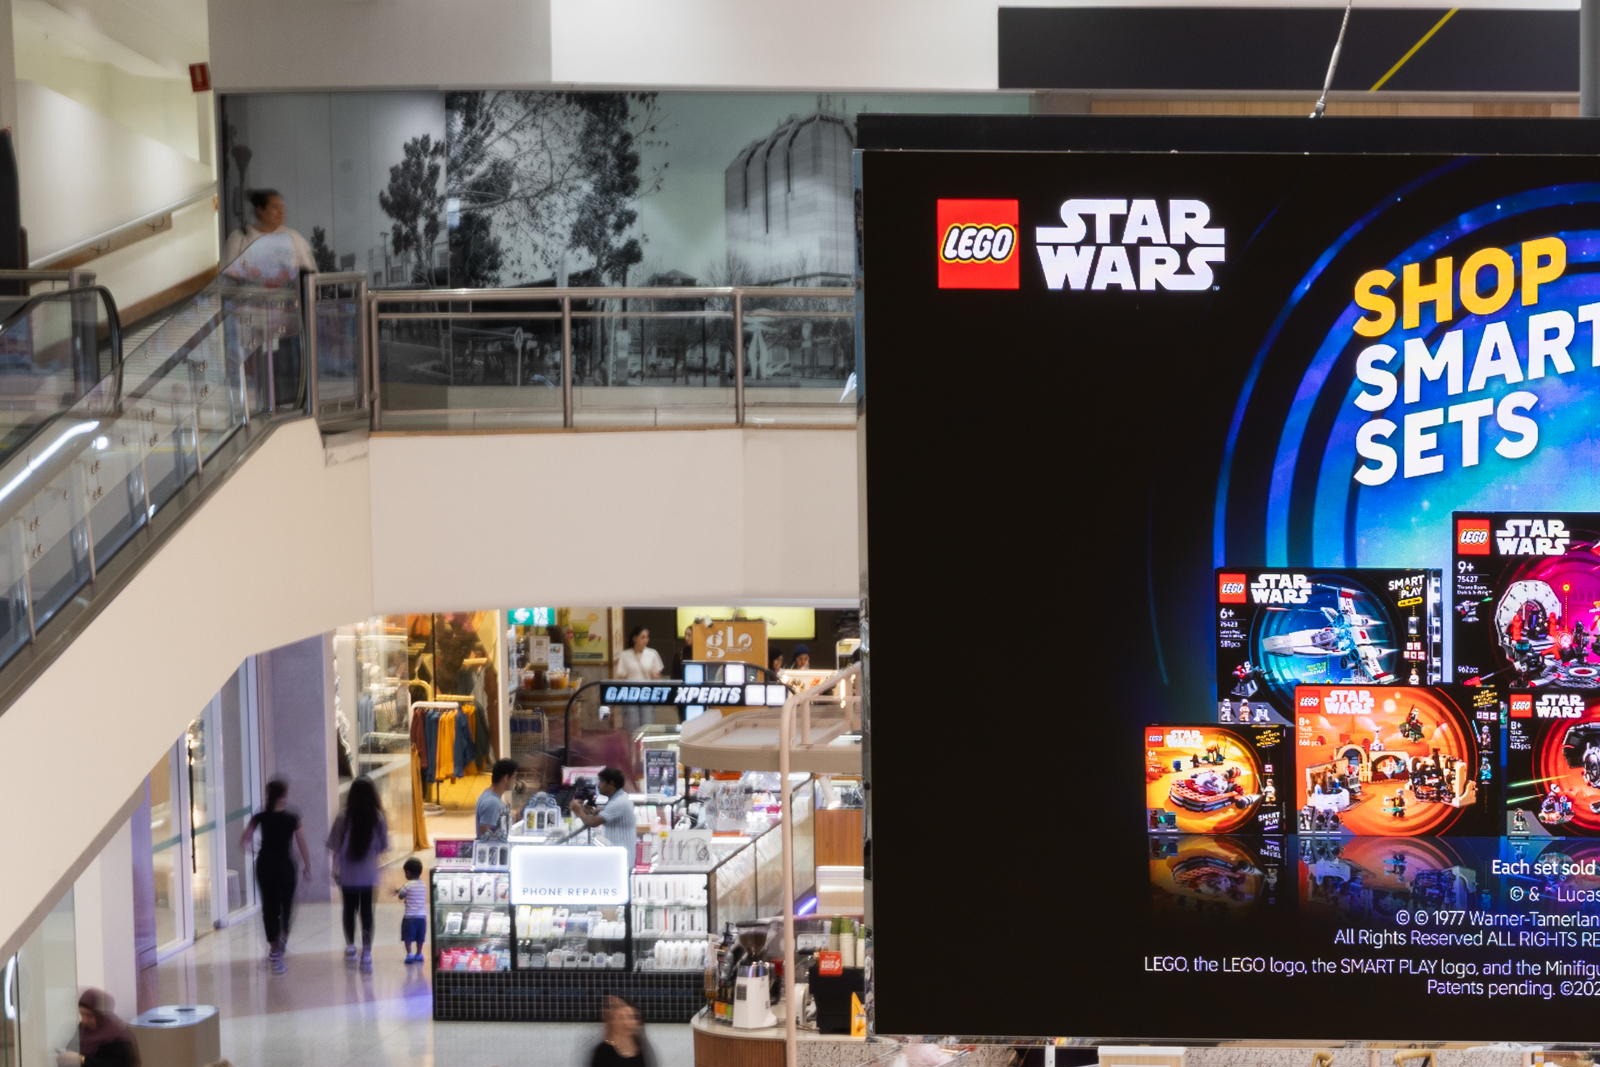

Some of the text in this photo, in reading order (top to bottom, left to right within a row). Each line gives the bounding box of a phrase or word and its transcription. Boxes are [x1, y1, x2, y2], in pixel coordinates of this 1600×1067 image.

[1035, 199, 1226, 244] STAR
[941, 223, 1016, 263] LEGO
[1035, 245, 1226, 291] WARS
[1352, 236, 1567, 338] SHOP
[1353, 390, 1540, 487] SETS
[1495, 519, 1571, 538] STAR
[1459, 528, 1489, 546] LEGO
[1495, 537, 1571, 556] WARS
[1457, 560, 1475, 574] 9+
[1221, 582, 1246, 594] LEGO
[1250, 573, 1313, 589] STAR
[1388, 575, 1426, 591] SMART
[1250, 588, 1313, 604] WARS
[1401, 586, 1424, 599] PLAY
[1219, 608, 1235, 619] 6+
[706, 626, 752, 659] glo
[605, 686, 741, 704] GADGET XPERTS
[1299, 697, 1319, 707] LEGO
[1324, 690, 1375, 703] STAR
[1535, 694, 1586, 707] STAR
[1324, 702, 1375, 715] WARS
[1511, 701, 1532, 711] LEGO
[1535, 705, 1586, 719] WARS
[1298, 717, 1310, 726] 8+
[1510, 721, 1523, 730] 8+
[1492, 859, 1529, 876] Each
[1534, 861, 1557, 876] set
[1561, 860, 1596, 876] sold
[522, 887, 618, 897] PHONE REPAIRS
[1529, 887, 1540, 902] &
[1432, 911, 1466, 926] 1977
[1335, 928, 1354, 945] All
[1358, 929, 1407, 949] Rights
[1411, 930, 1483, 947] Reserved
[1487, 931, 1516, 947] ALL
[1520, 932, 1578, 947] RIGHTS
[1144, 956, 1190, 973] LEGO,
[1194, 957, 1219, 972] the
[1223, 957, 1266, 972] LEGO
[1270, 957, 1308, 977] logo,
[1312, 958, 1337, 973] the
[1341, 958, 1395, 974] SMART
[1400, 959, 1437, 974] PLAY
[1441, 959, 1480, 978] logo,
[1483, 960, 1512, 975] and
[1516, 960, 1541, 975] the
[1428, 979, 1484, 995] Patents
[1488, 980, 1556, 1000] pending.
